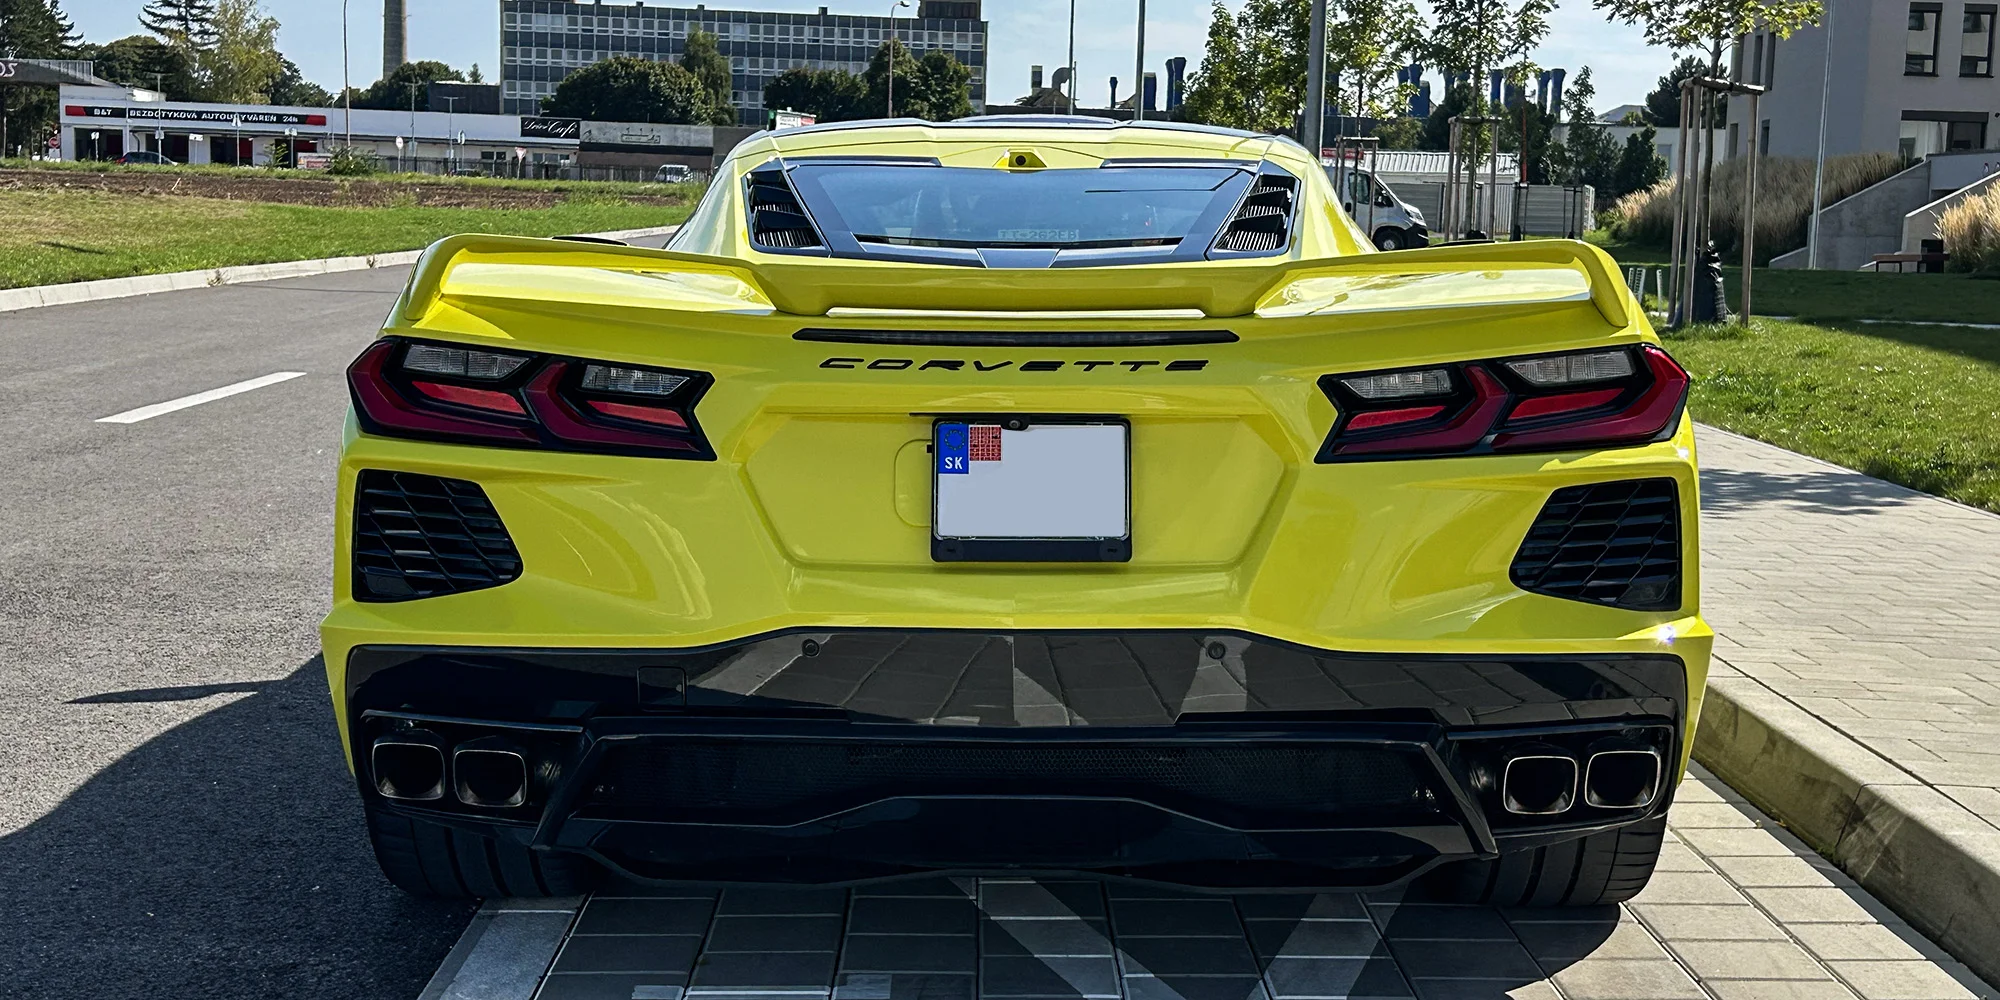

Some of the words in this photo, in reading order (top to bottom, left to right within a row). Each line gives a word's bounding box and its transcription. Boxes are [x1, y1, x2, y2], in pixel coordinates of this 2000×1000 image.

[94, 108, 112, 116] B&T
[819, 357, 1209, 372] CORVETTE
[944, 456, 963, 470] SK
